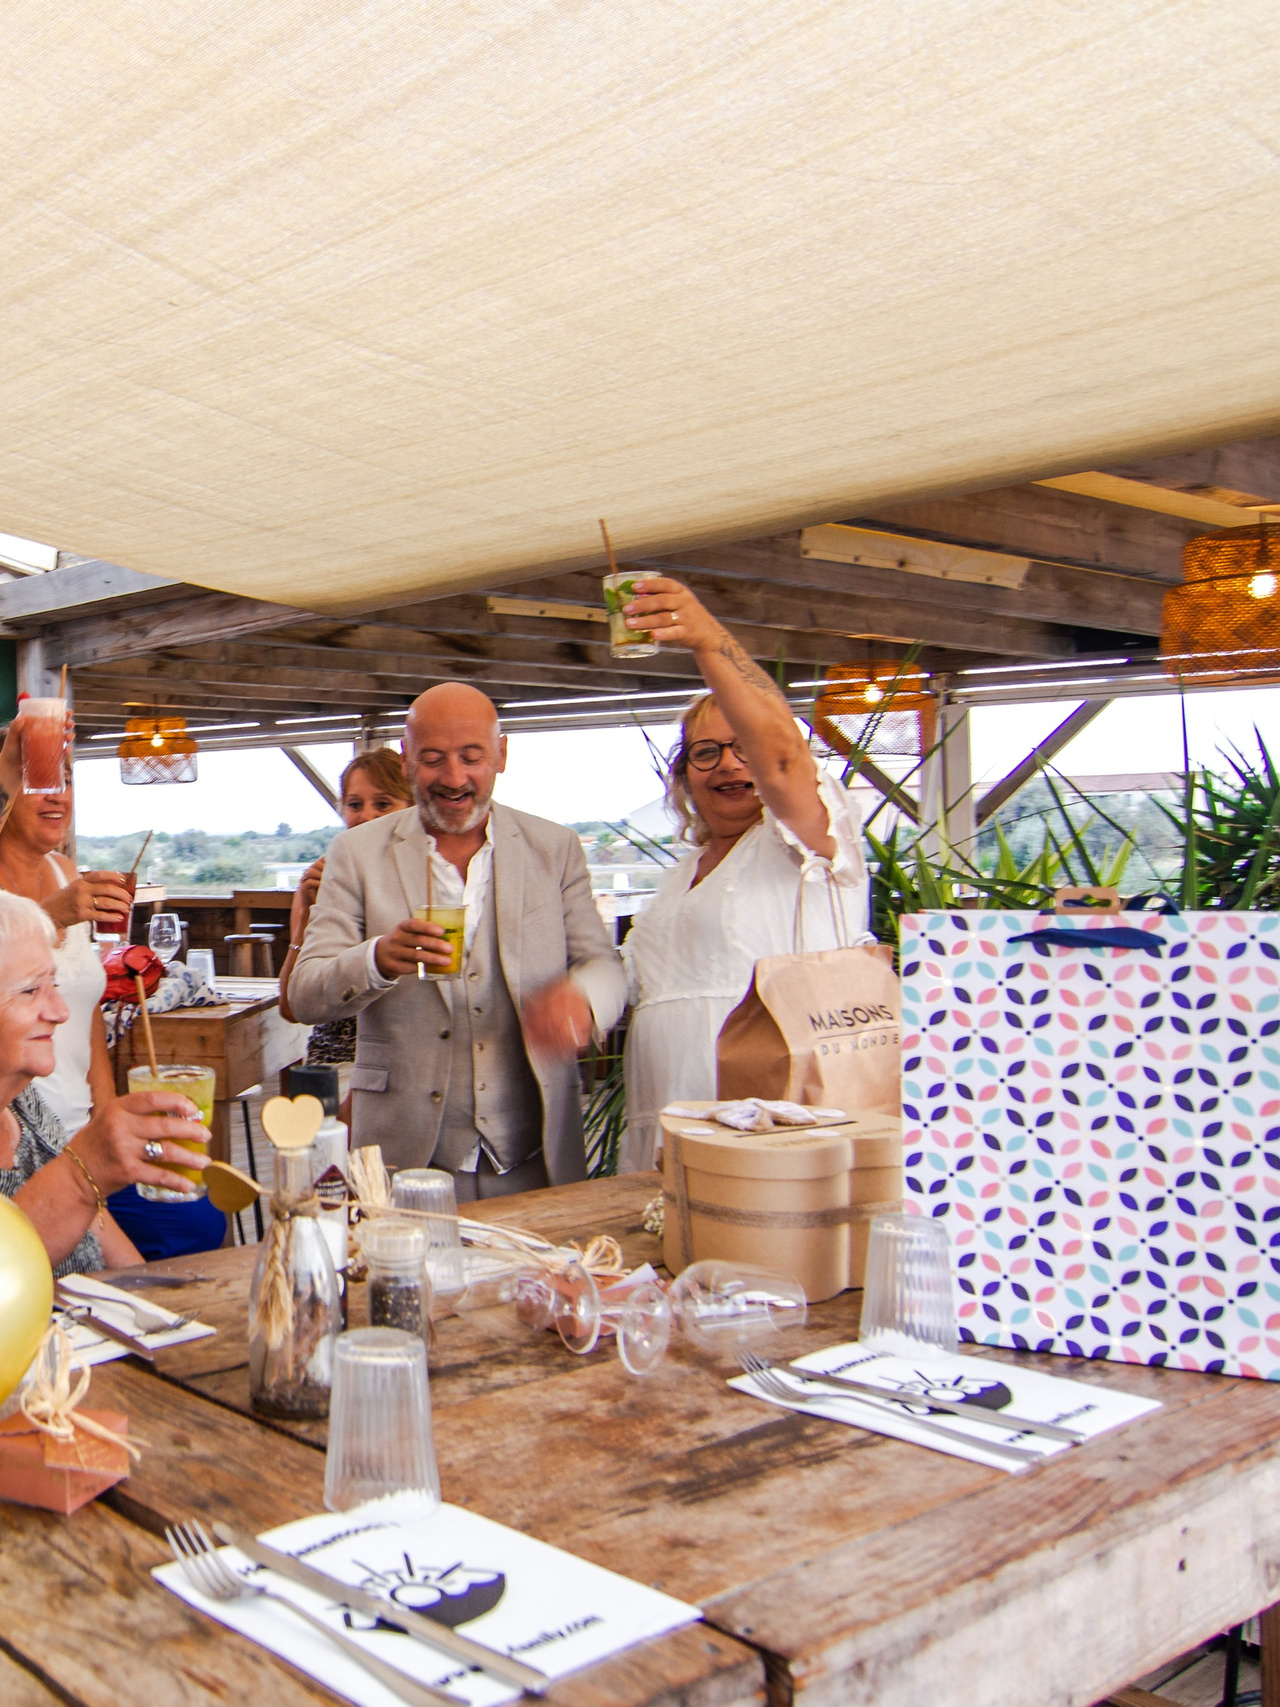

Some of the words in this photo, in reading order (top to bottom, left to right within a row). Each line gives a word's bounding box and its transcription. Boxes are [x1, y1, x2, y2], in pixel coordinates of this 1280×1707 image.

[808, 1004, 895, 1032] MAISONS
[821, 1043, 841, 1056] DU
[852, 1033, 899, 1052] MONDE
